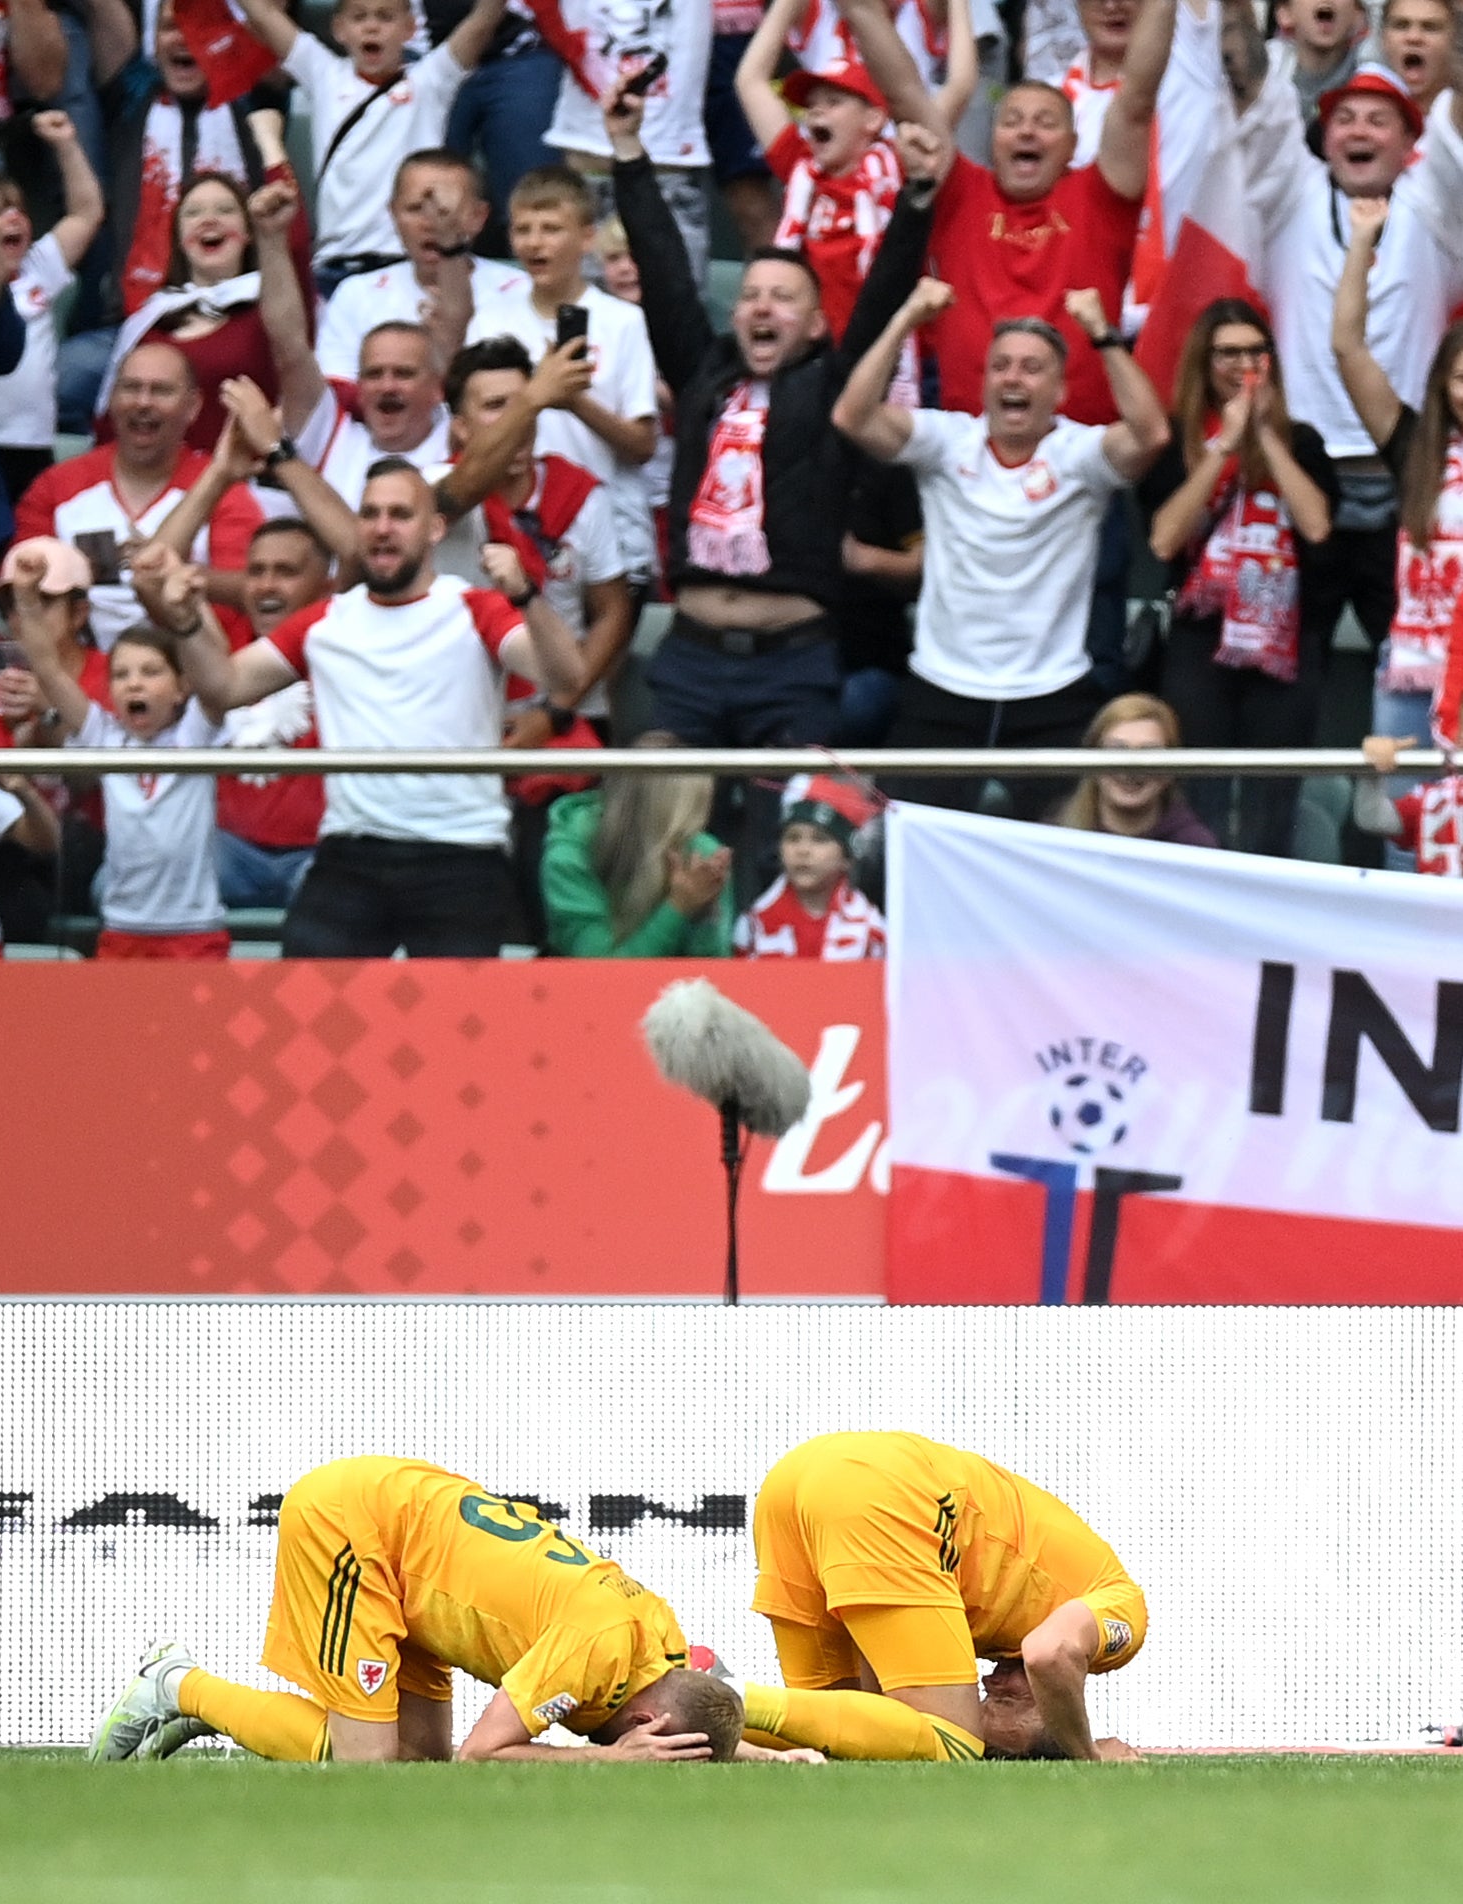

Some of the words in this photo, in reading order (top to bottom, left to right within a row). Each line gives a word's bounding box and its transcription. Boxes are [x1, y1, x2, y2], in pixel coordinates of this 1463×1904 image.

[762, 1023, 890, 1196] Ł
[1034, 1035, 1149, 1083] INTER
[1249, 960, 1463, 1135] IN
